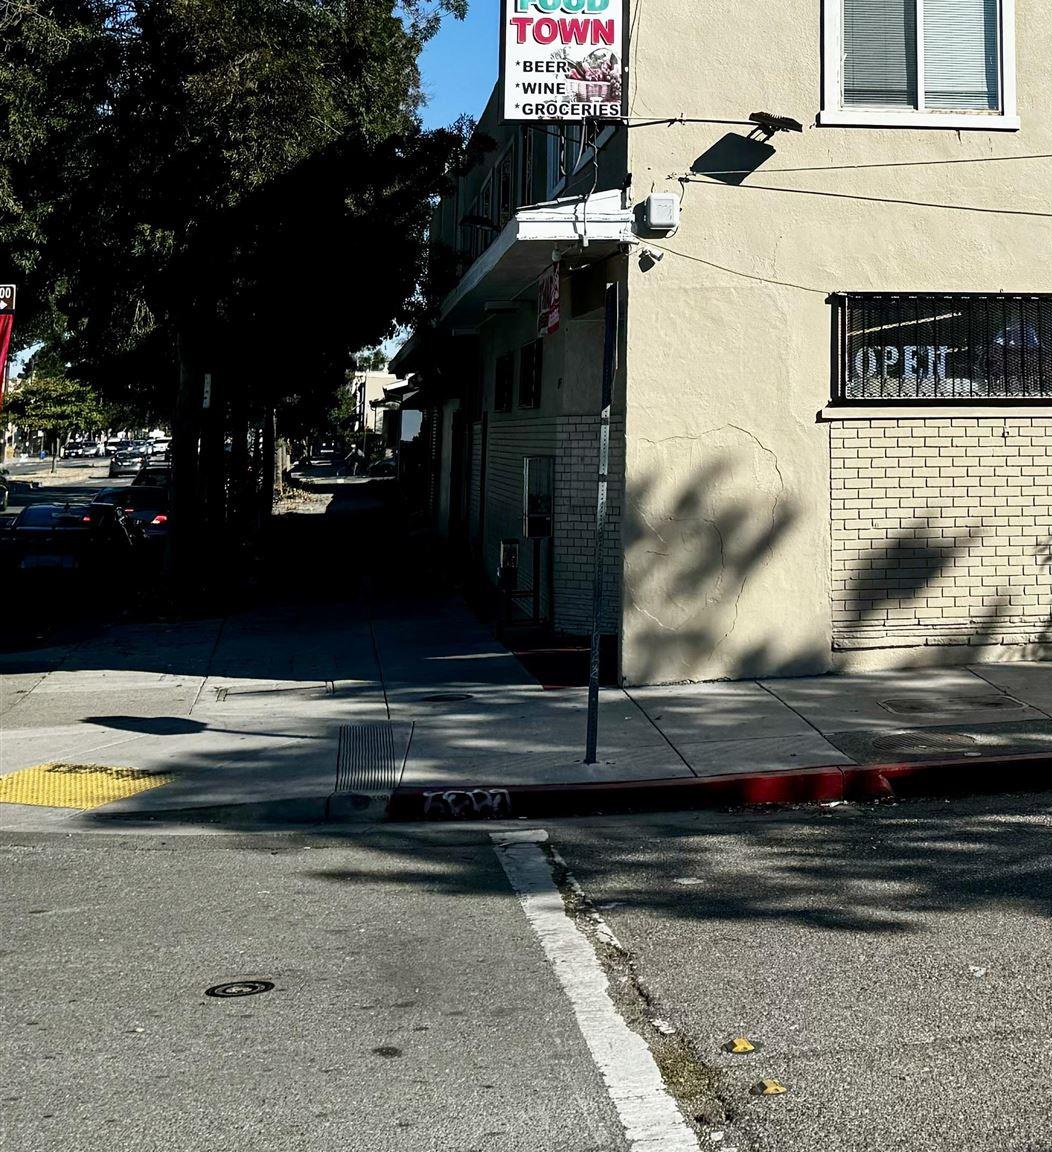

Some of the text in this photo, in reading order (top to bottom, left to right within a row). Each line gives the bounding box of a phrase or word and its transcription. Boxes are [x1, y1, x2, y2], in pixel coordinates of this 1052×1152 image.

[510, 17, 615, 45] TOWN
[522, 60, 567, 73] BEER
[522, 82, 566, 95] WINE
[521, 103, 619, 116] GROCERIES
[854, 345, 948, 379] OPEN
